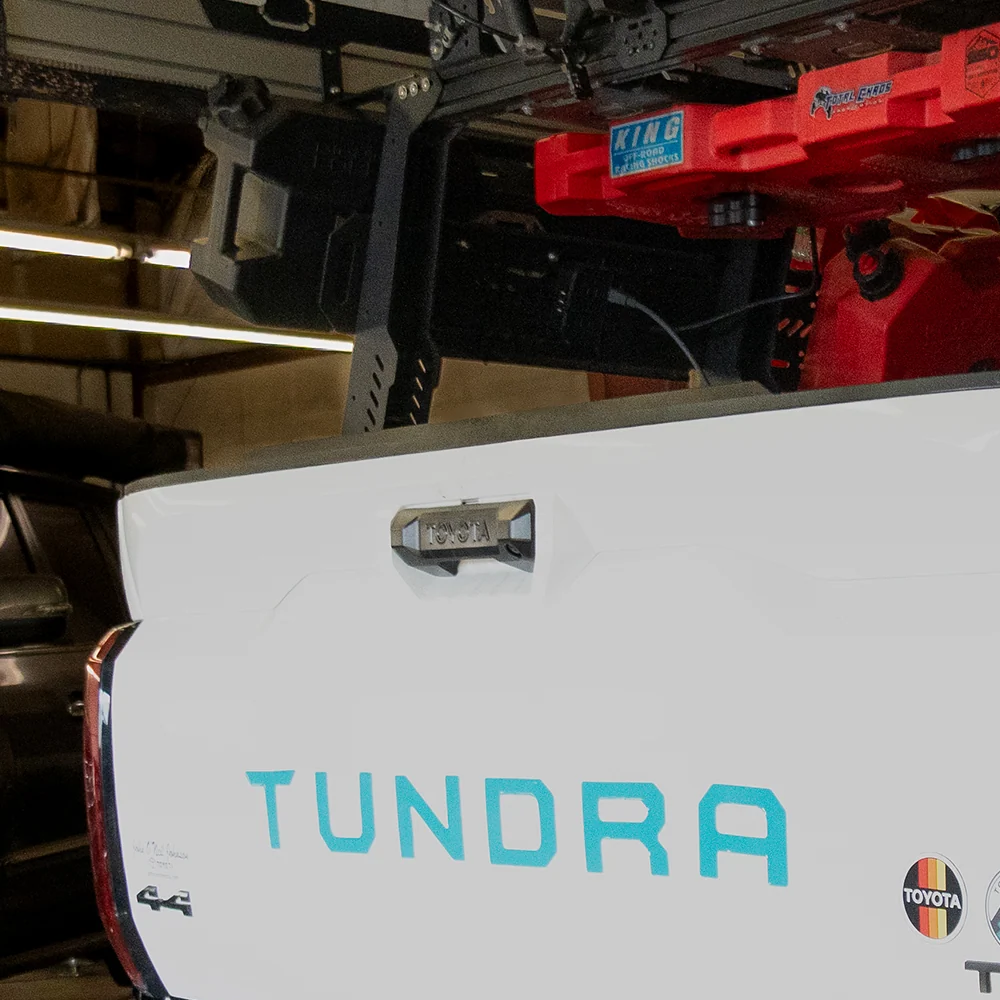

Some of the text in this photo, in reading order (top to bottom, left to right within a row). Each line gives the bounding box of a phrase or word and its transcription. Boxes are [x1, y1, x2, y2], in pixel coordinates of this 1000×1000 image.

[614, 117, 680, 150] KING
[615, 153, 679, 174] RACING SHOCKS
[624, 147, 665, 162] OFF-ROAD
[426, 519, 490, 545] TOYOTA
[246, 770, 788, 887] TUNDRA
[903, 887, 962, 910] TOYOTA
